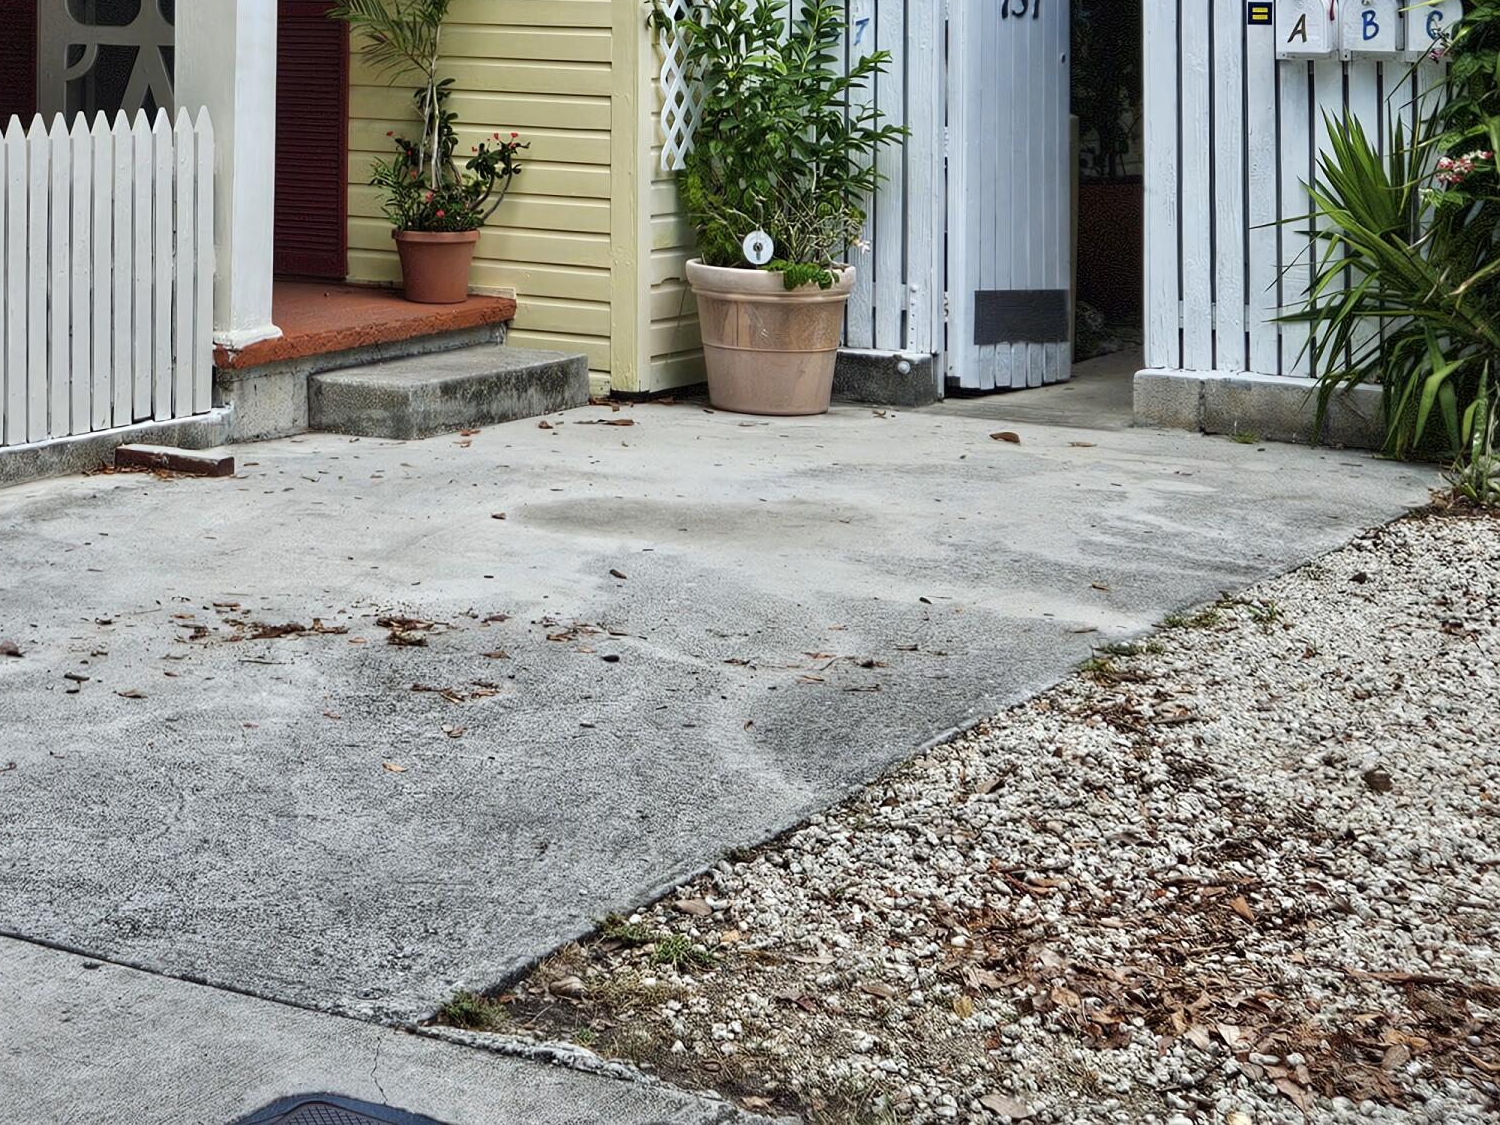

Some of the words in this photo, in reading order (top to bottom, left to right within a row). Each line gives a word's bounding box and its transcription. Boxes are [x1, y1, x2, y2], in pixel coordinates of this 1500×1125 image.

[1287, 13, 1307, 44] A
[1361, 9, 1380, 41] B
[1425, 10, 1444, 41] C
